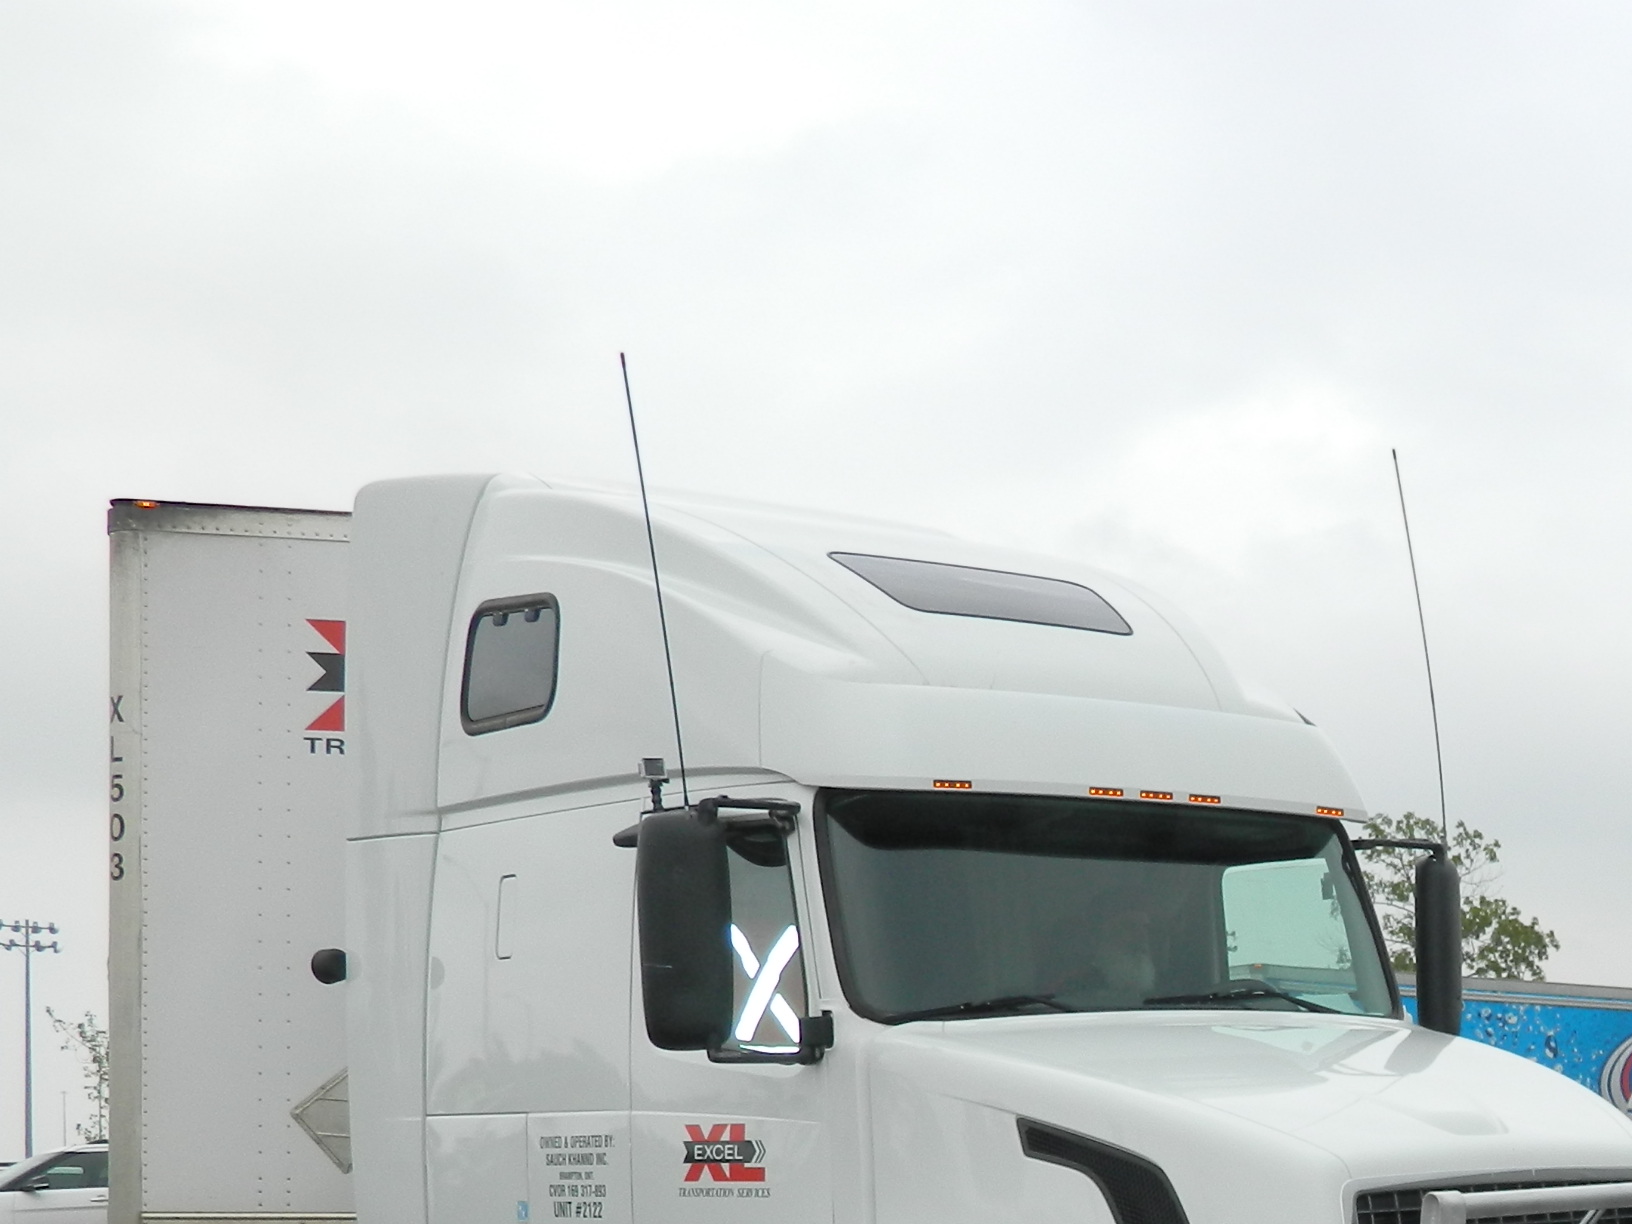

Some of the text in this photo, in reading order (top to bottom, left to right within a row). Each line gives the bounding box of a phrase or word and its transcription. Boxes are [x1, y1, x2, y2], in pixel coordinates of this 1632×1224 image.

[109, 695, 126, 881] XL503
[540, 1135, 562, 1149] OWNED
[570, 1134, 603, 1149] OPERATED
[683, 1123, 766, 1182] XL
[693, 1144, 744, 1160] EXCEL
[678, 1187, 771, 1198] TRANSPORTATION SERVICES
[553, 1201, 603, 1219] UNIT #2122
